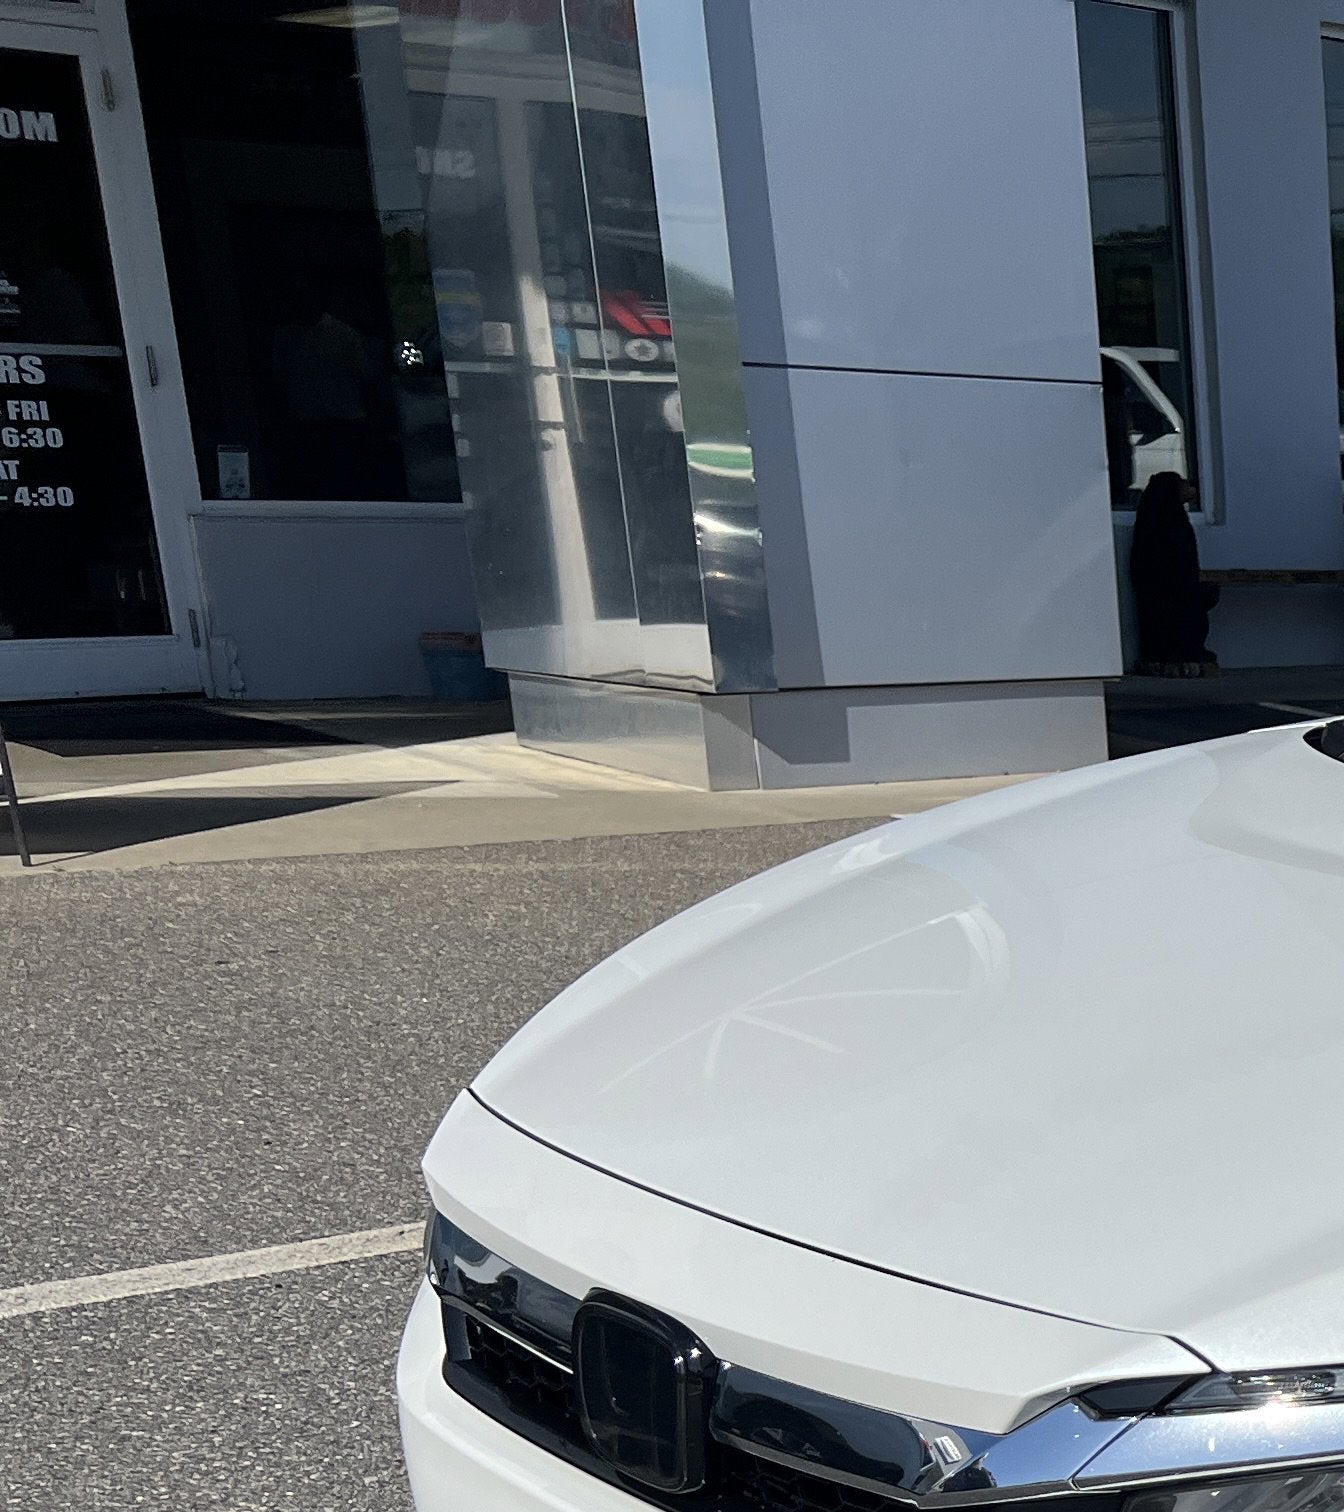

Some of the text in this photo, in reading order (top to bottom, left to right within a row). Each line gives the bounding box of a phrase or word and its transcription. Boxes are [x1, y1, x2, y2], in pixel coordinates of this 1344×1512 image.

[0, 354, 46, 385] RS
[6, 399, 50, 421] FRI
[1, 427, 64, 448] 6:30
[14, 486, 75, 507] 4:30
